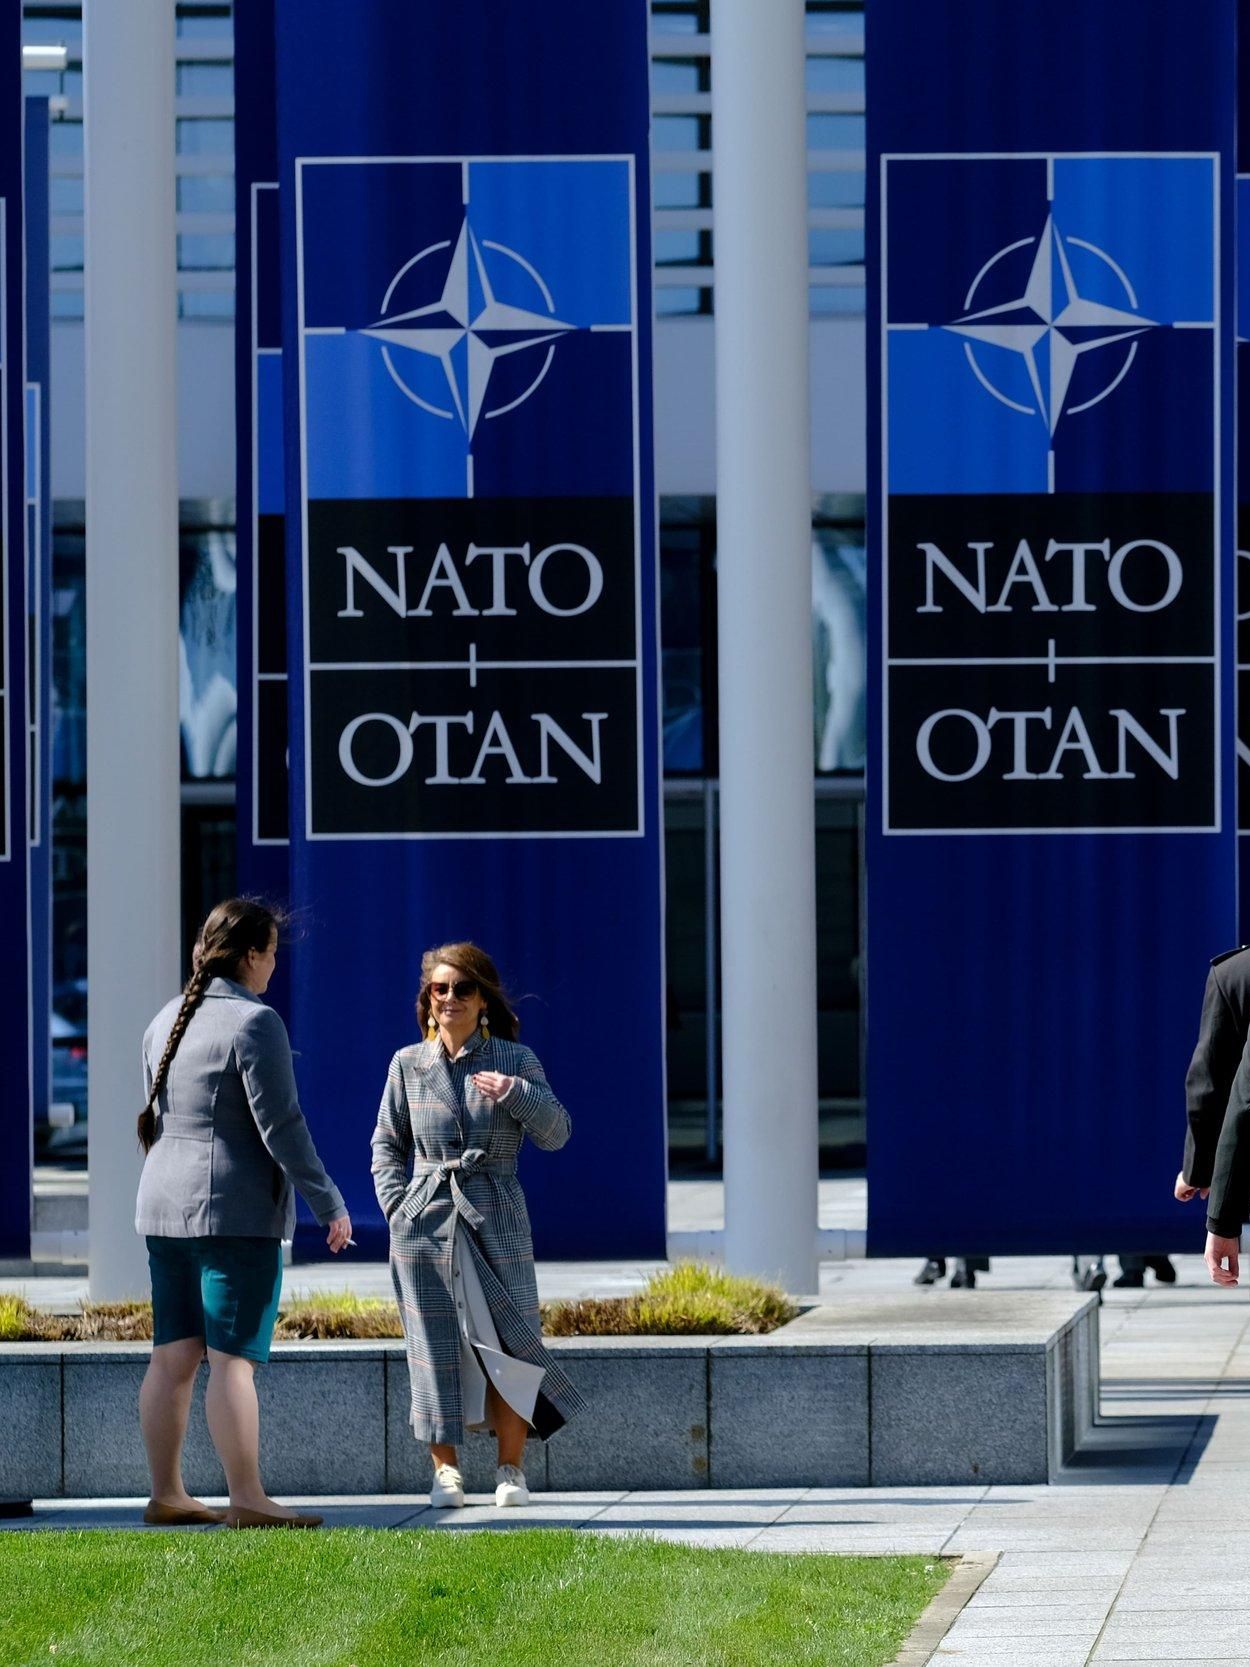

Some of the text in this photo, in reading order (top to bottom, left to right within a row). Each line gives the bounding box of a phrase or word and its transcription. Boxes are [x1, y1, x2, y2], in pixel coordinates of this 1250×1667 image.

[337, 541, 604, 620] NATO
[916, 538, 1183, 614] NATO
[337, 710, 609, 787] OTAN
[915, 706, 1187, 782] OTAN
